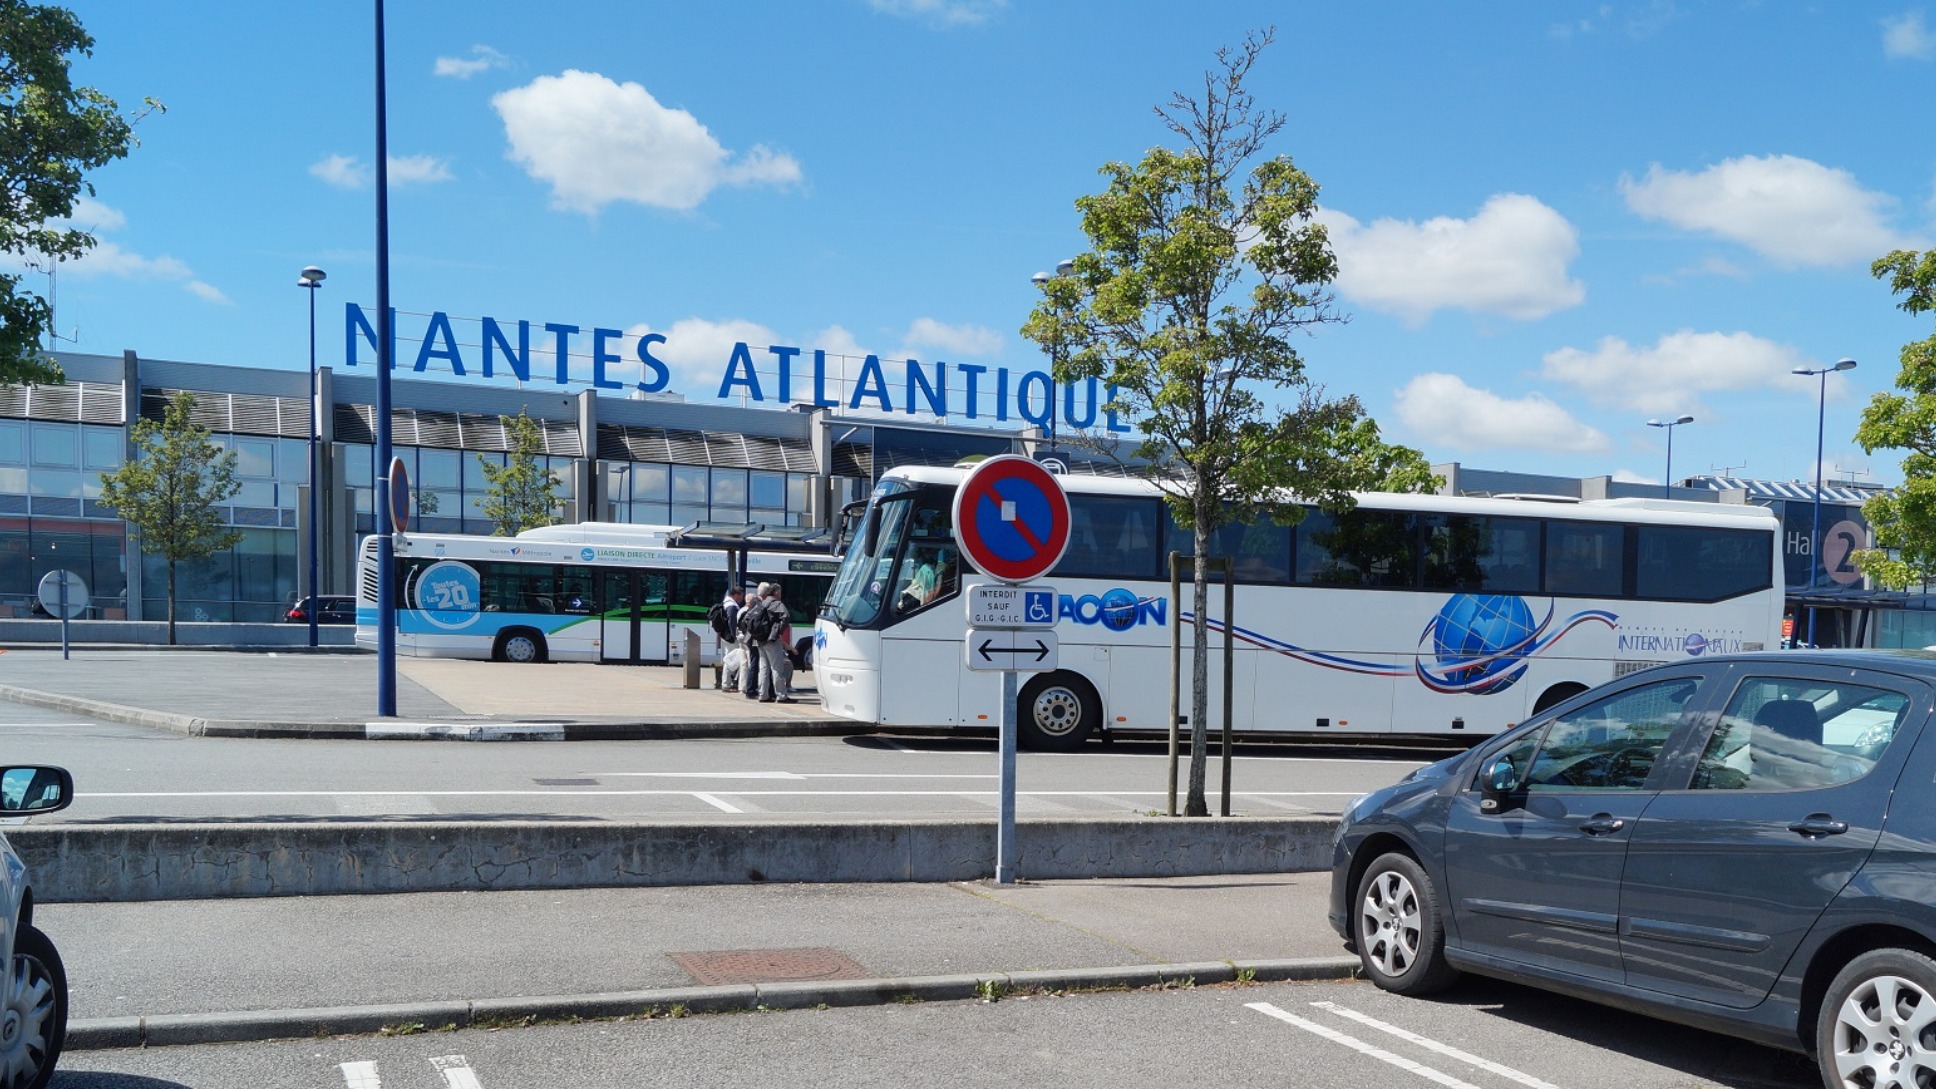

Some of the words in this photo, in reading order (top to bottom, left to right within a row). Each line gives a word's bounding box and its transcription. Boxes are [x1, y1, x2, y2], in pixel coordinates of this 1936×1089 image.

[346, 302, 670, 393] NANTES
[717, 341, 1131, 439] ATLANTIQUE
[597, 549, 625, 557] LIAISON
[627, 551, 656, 559] DIRECTE
[1835, 531, 1857, 573] 2
[431, 580, 459, 590] Toutes
[434, 584, 470, 609] 20
[979, 590, 1018, 599] INTERDIT
[987, 602, 1010, 611] SAUF
[1058, 588, 1167, 632] ACON
